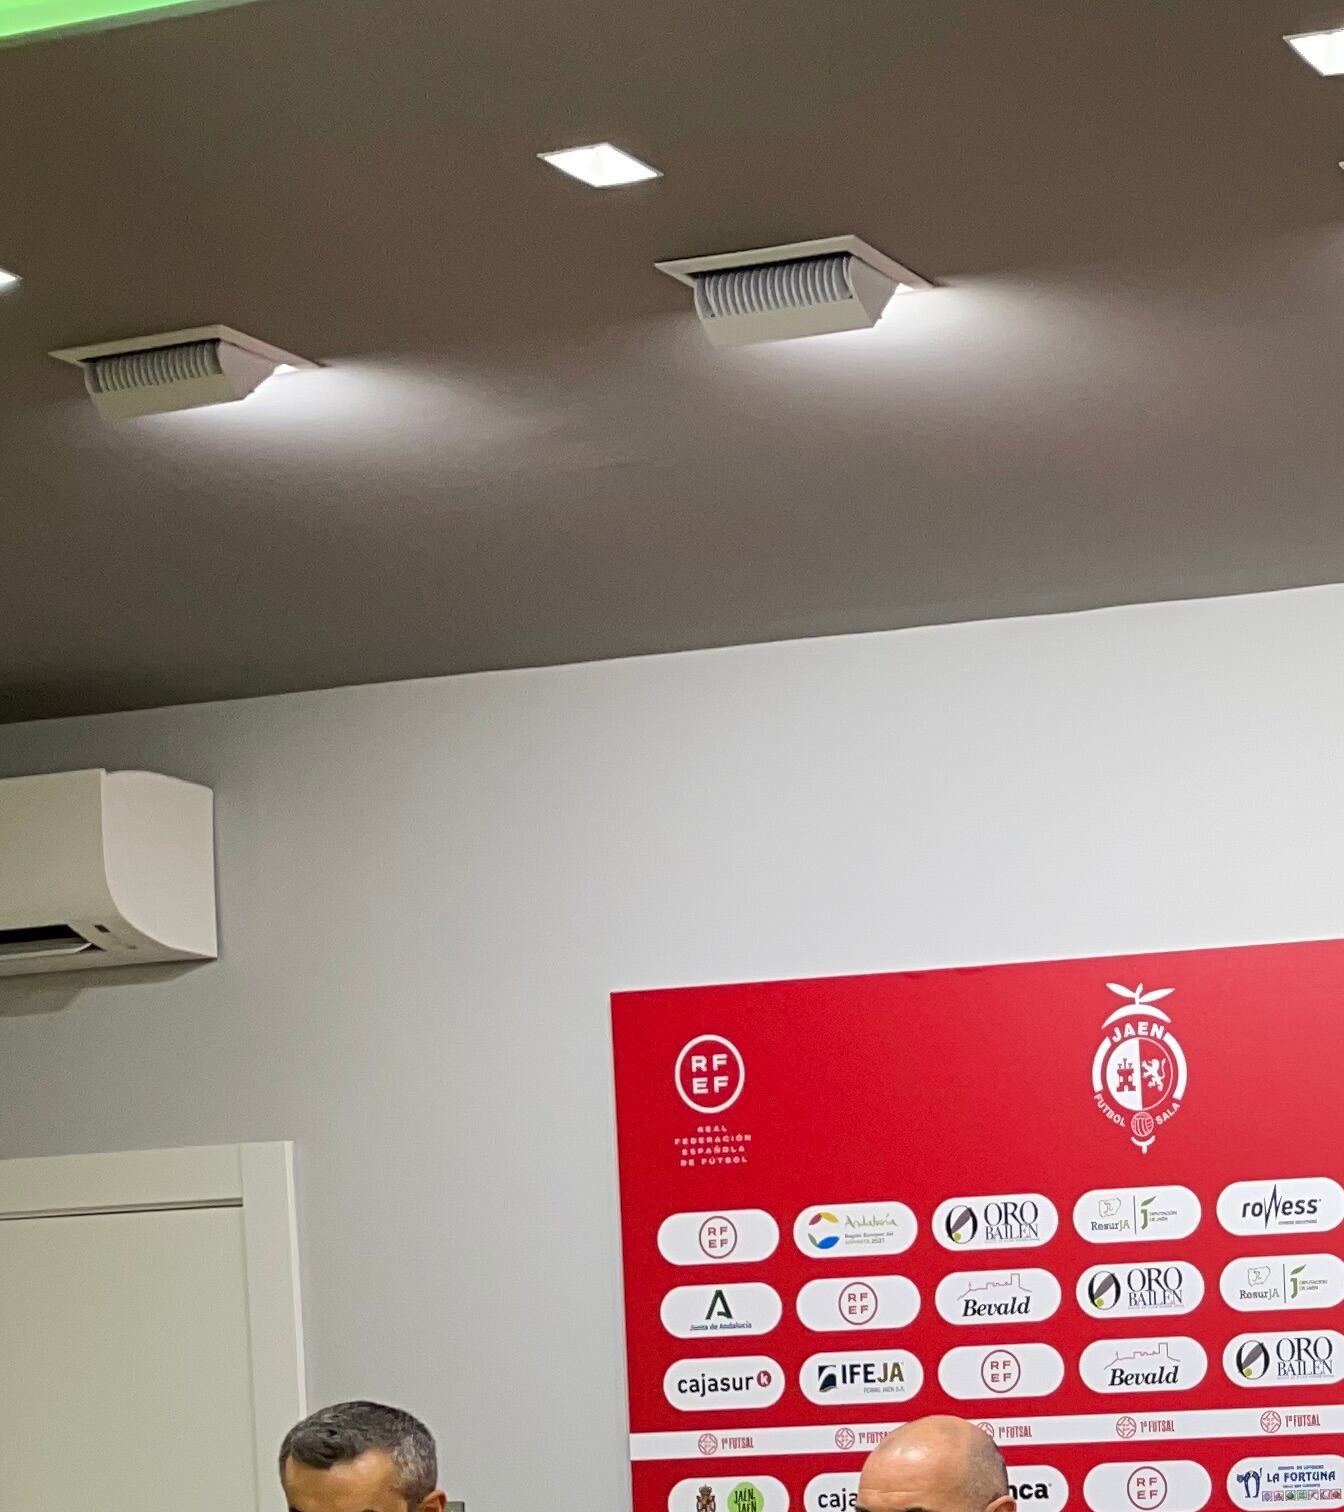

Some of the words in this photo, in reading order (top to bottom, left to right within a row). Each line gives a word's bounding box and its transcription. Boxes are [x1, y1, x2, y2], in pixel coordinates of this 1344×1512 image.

[1111, 1022, 1164, 1043] JAEN
[1094, 1093, 1126, 1128] FUTBOL
[1156, 1102, 1180, 1125] SALA
[697, 1125, 727, 1133] REAL
[984, 1201, 1038, 1226] ORO
[1127, 1267, 1182, 1292] ORO
[962, 1297, 1031, 1317] Bevald
[1276, 1337, 1332, 1362] ORO
[842, 1362, 904, 1384] IFEJA
[1109, 1365, 1179, 1386] Bevald
[677, 1374, 753, 1397] cajasur
[1148, 1419, 1175, 1433] FUTSAL
[1294, 1413, 1320, 1427] FUTSAL
[730, 1435, 754, 1449] FUTSAL
[1006, 1425, 1032, 1438] FUTSAL
[1267, 1472, 1280, 1482] LA
[1284, 1469, 1336, 1482] FORTUNA
